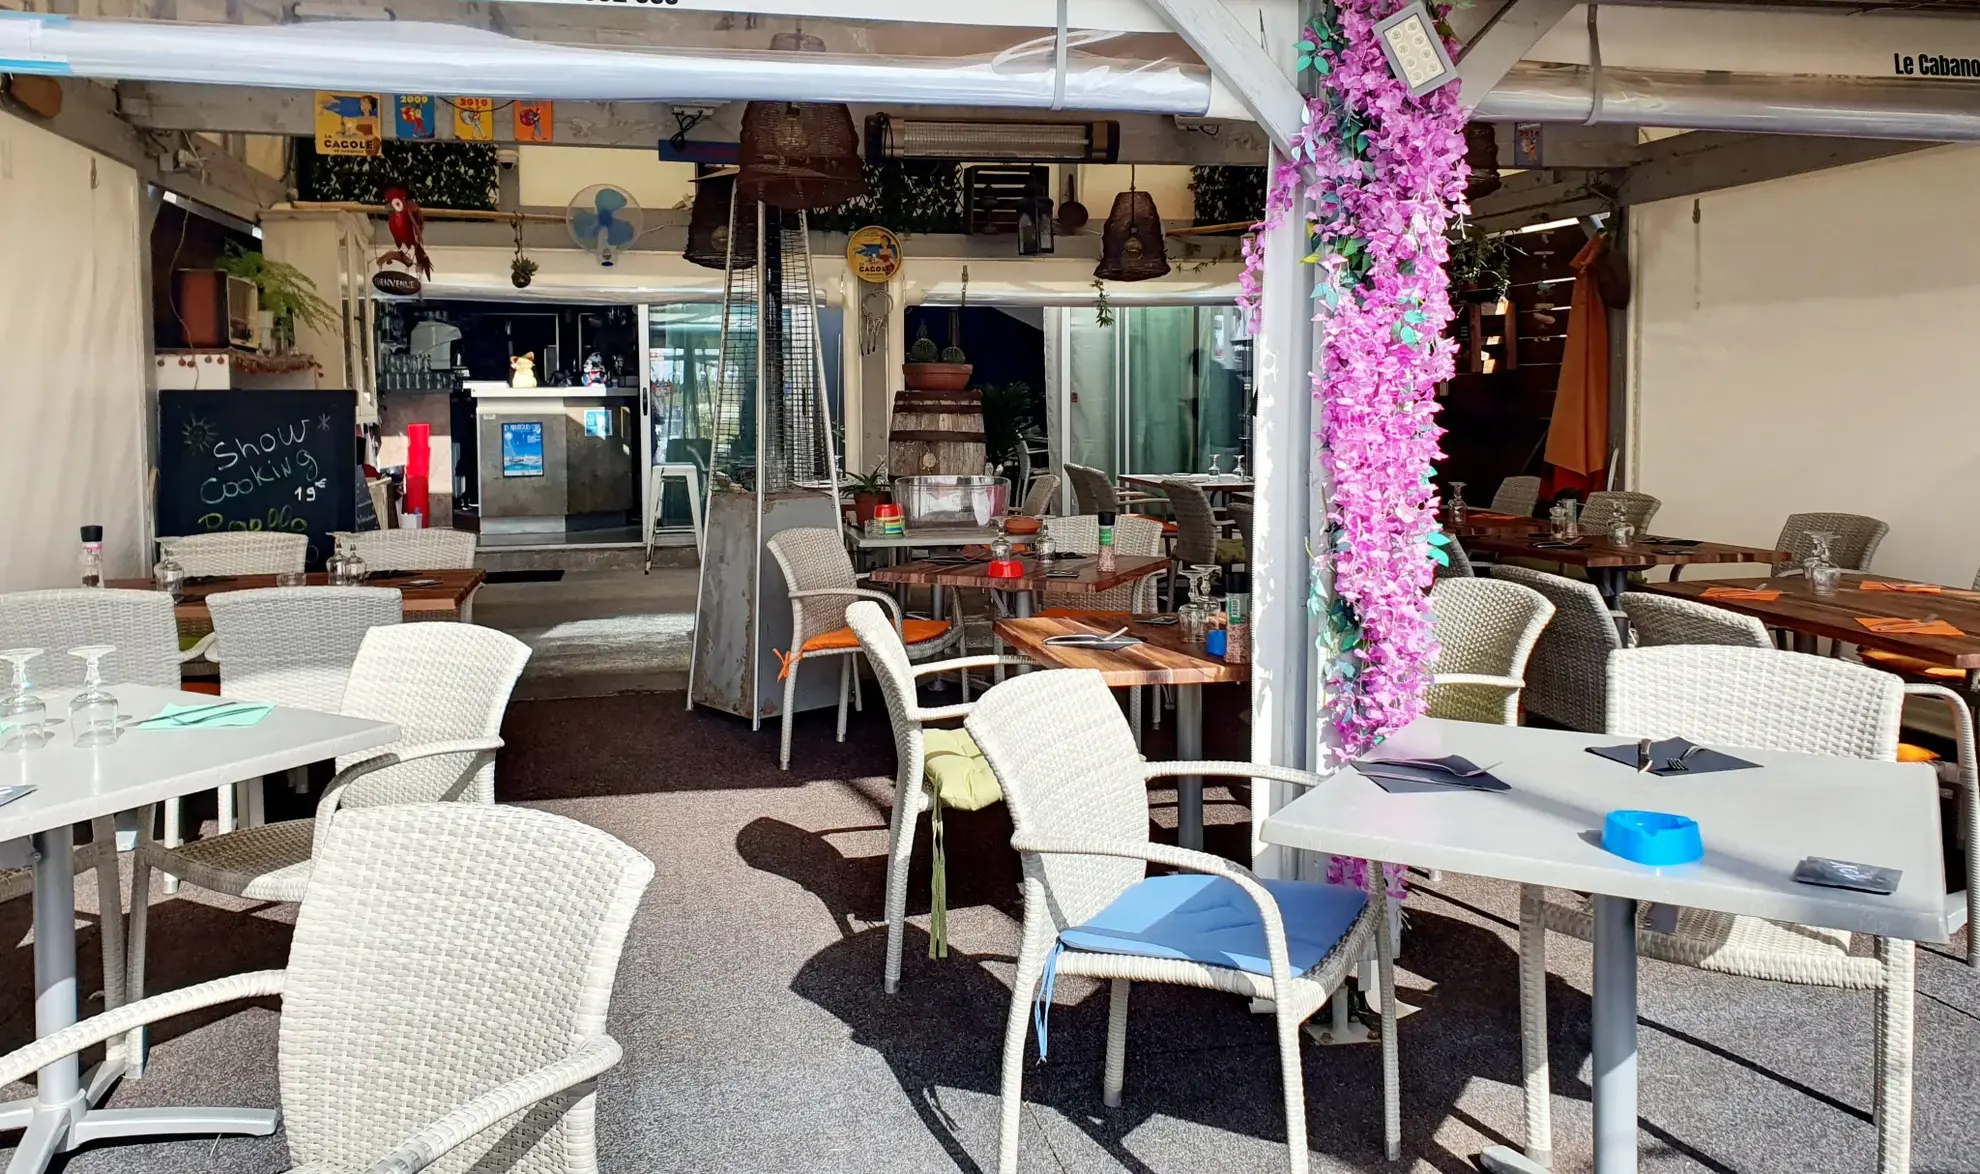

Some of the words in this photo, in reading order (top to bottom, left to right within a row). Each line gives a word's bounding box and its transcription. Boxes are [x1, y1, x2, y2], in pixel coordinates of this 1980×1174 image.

[1894, 52, 1914, 75] Le
[1918, 53, 1980, 77] Cabano
[460, 98, 488, 106] 2010
[323, 139, 373, 149] CAGOLE
[213, 418, 310, 471] Show
